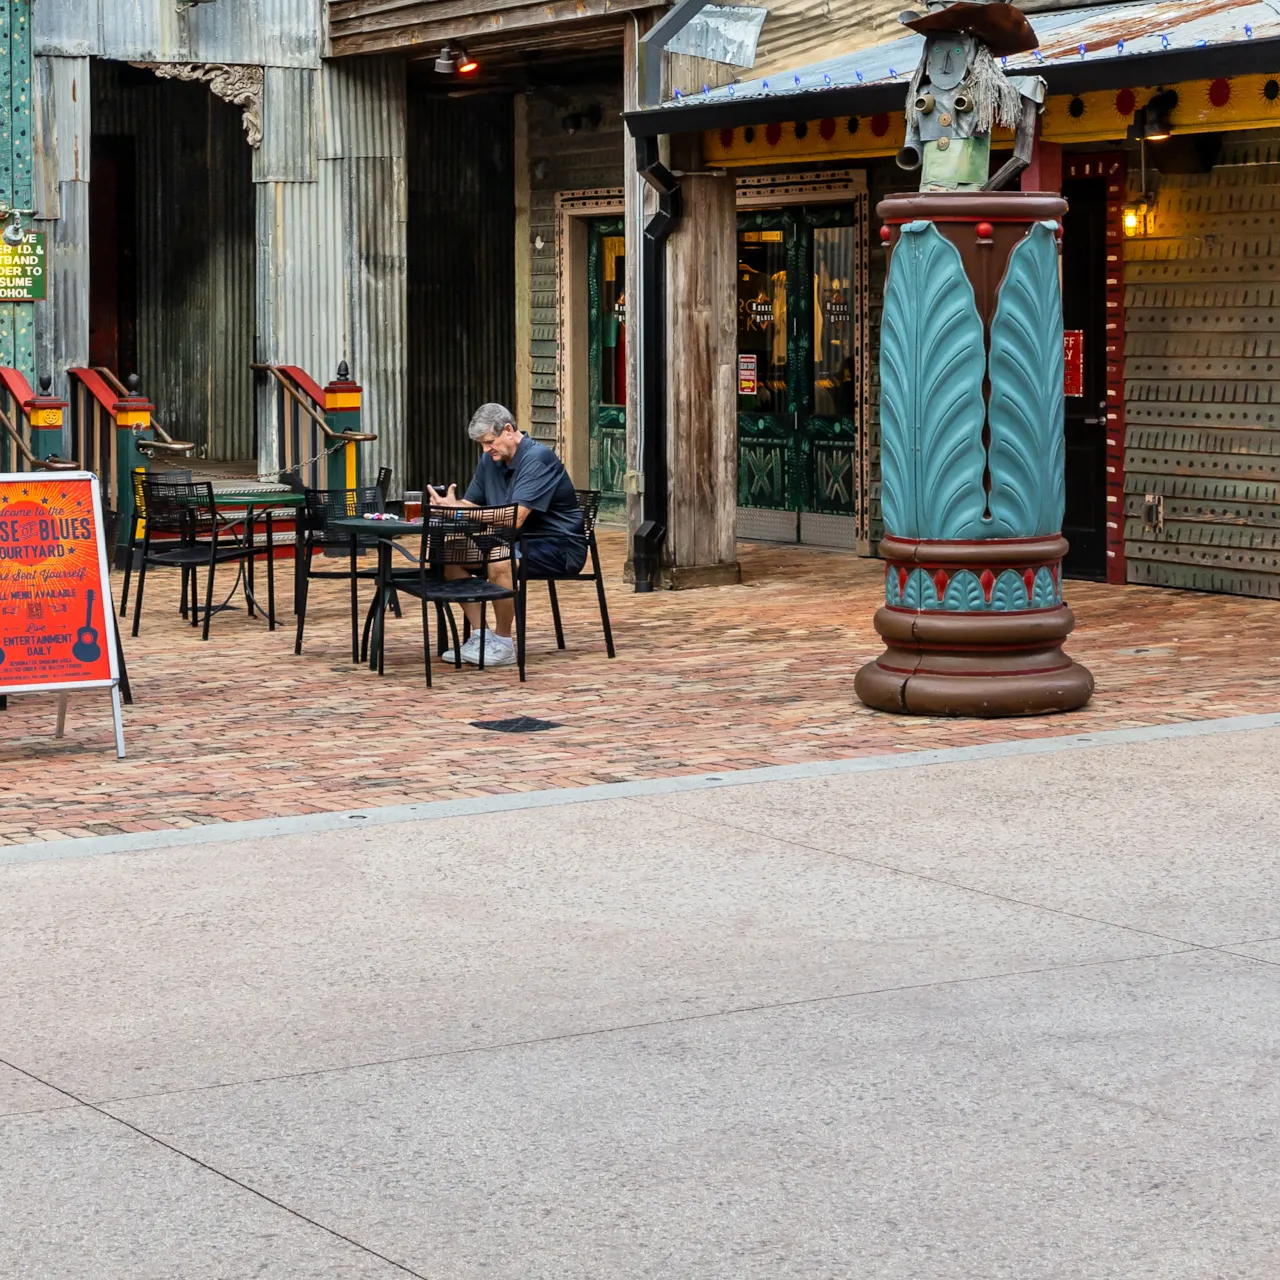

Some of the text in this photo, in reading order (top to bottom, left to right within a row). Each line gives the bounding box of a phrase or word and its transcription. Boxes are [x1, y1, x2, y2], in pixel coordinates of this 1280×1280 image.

[17, 245, 33, 254] I.D.
[36, 245, 44, 255] &
[25, 266, 42, 276] TO
[35, 506, 46, 517] to
[47, 505, 65, 516] the
[39, 517, 92, 542] BLUES
[12, 568, 37, 582] Seat
[39, 566, 88, 583] Yourself
[11, 590, 32, 600] MENU
[35, 588, 77, 599] AVAILABLE
[3, 633, 73, 647] ENTERTAINMENT
[27, 646, 52, 657] DAILY
